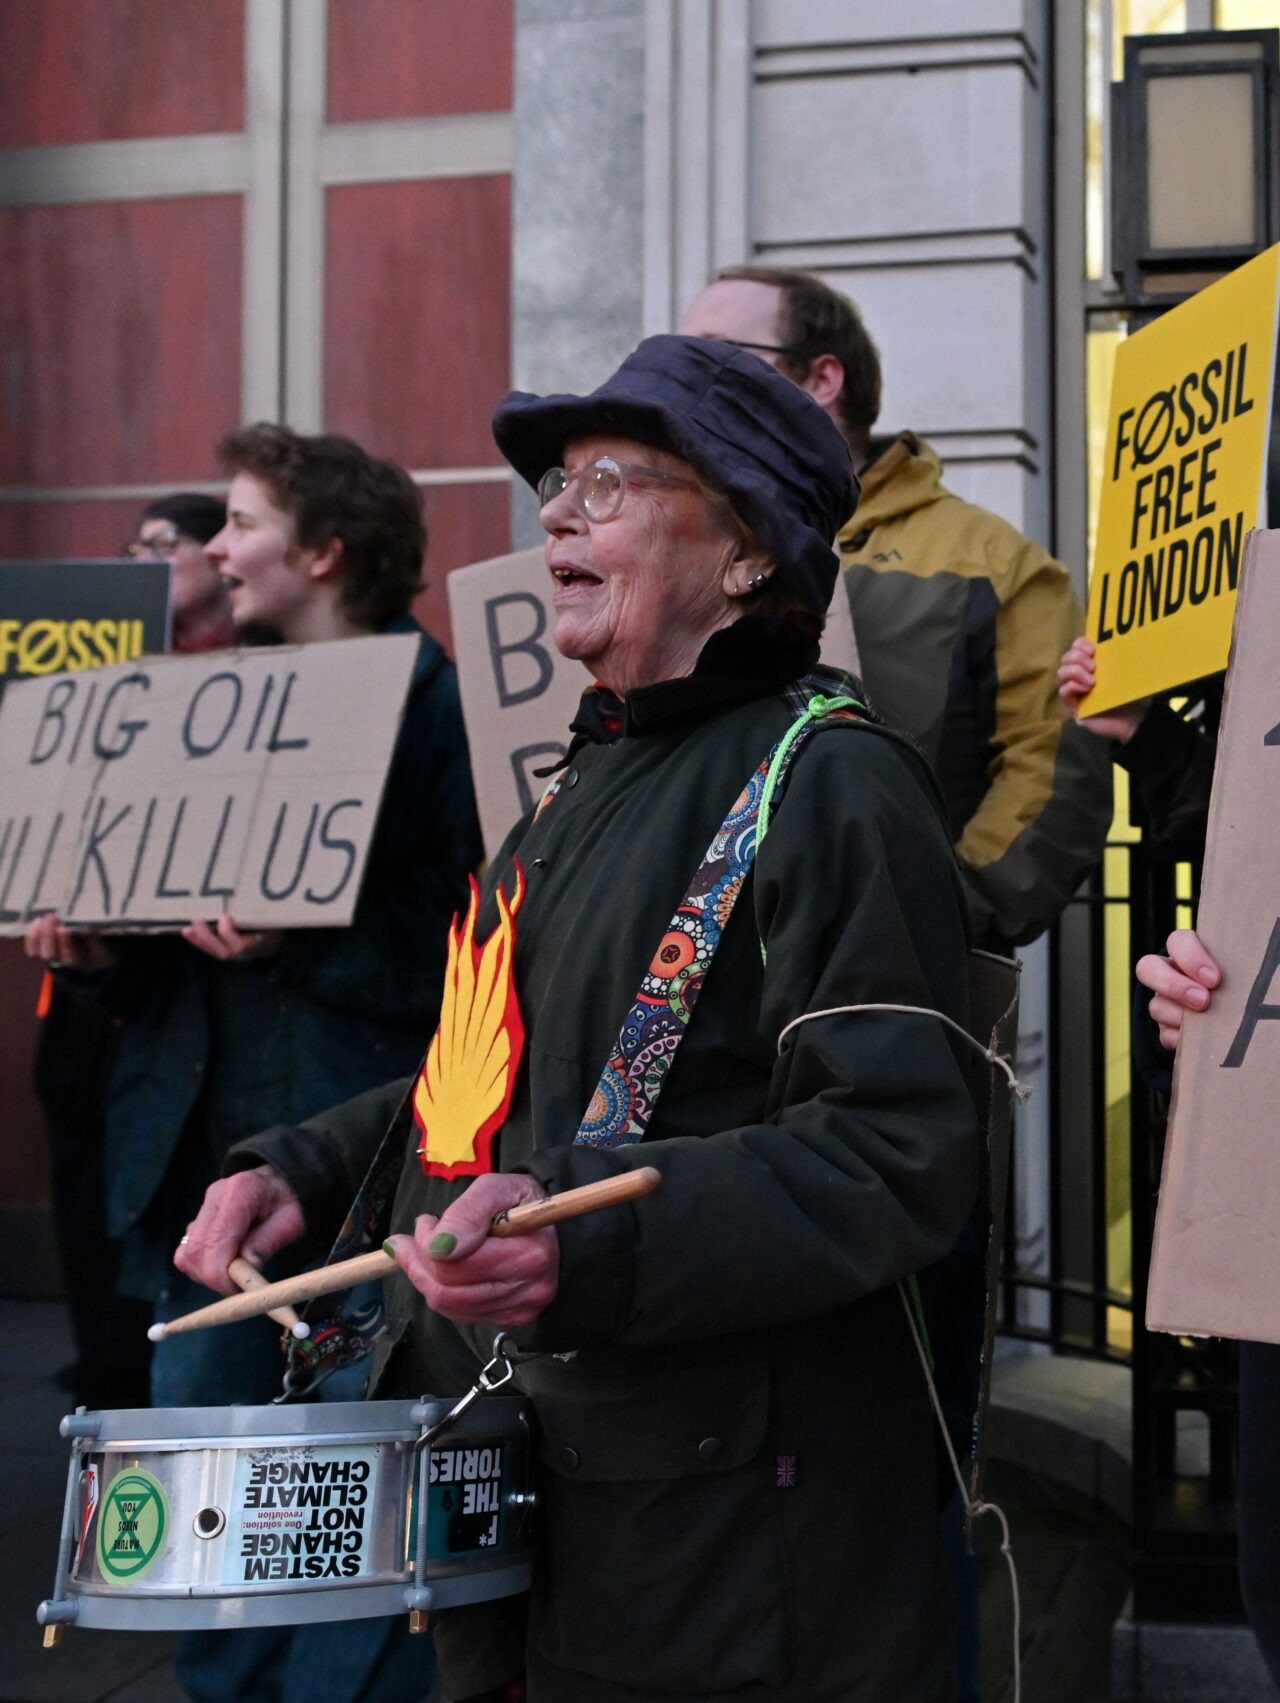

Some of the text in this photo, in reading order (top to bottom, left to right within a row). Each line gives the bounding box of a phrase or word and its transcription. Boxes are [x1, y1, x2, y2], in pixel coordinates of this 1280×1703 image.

[1112, 342, 1255, 482] FØSSIL
[1130, 437, 1222, 550] FREE
[1096, 511, 1245, 644] LONDON
[30, 672, 309, 765] BIG OIL
[66, 795, 235, 916] KILL
[260, 799, 363, 905] US
[249, 1460, 370, 1485] CHANGE
[429, 1447, 501, 1483] TORIES
[122, 1502, 136, 1513] YOU
[243, 1484, 368, 1509] CLIMATE
[462, 1481, 499, 1515] THE
[118, 1521, 138, 1532] NEEDS
[242, 1520, 303, 1530] One solution:
[257, 1510, 303, 1519] revolution
[305, 1507, 365, 1531] NOT
[114, 1539, 139, 1550] NATURE
[240, 1531, 363, 1557] CHANGE
[243, 1554, 362, 1581] SYSTEM
